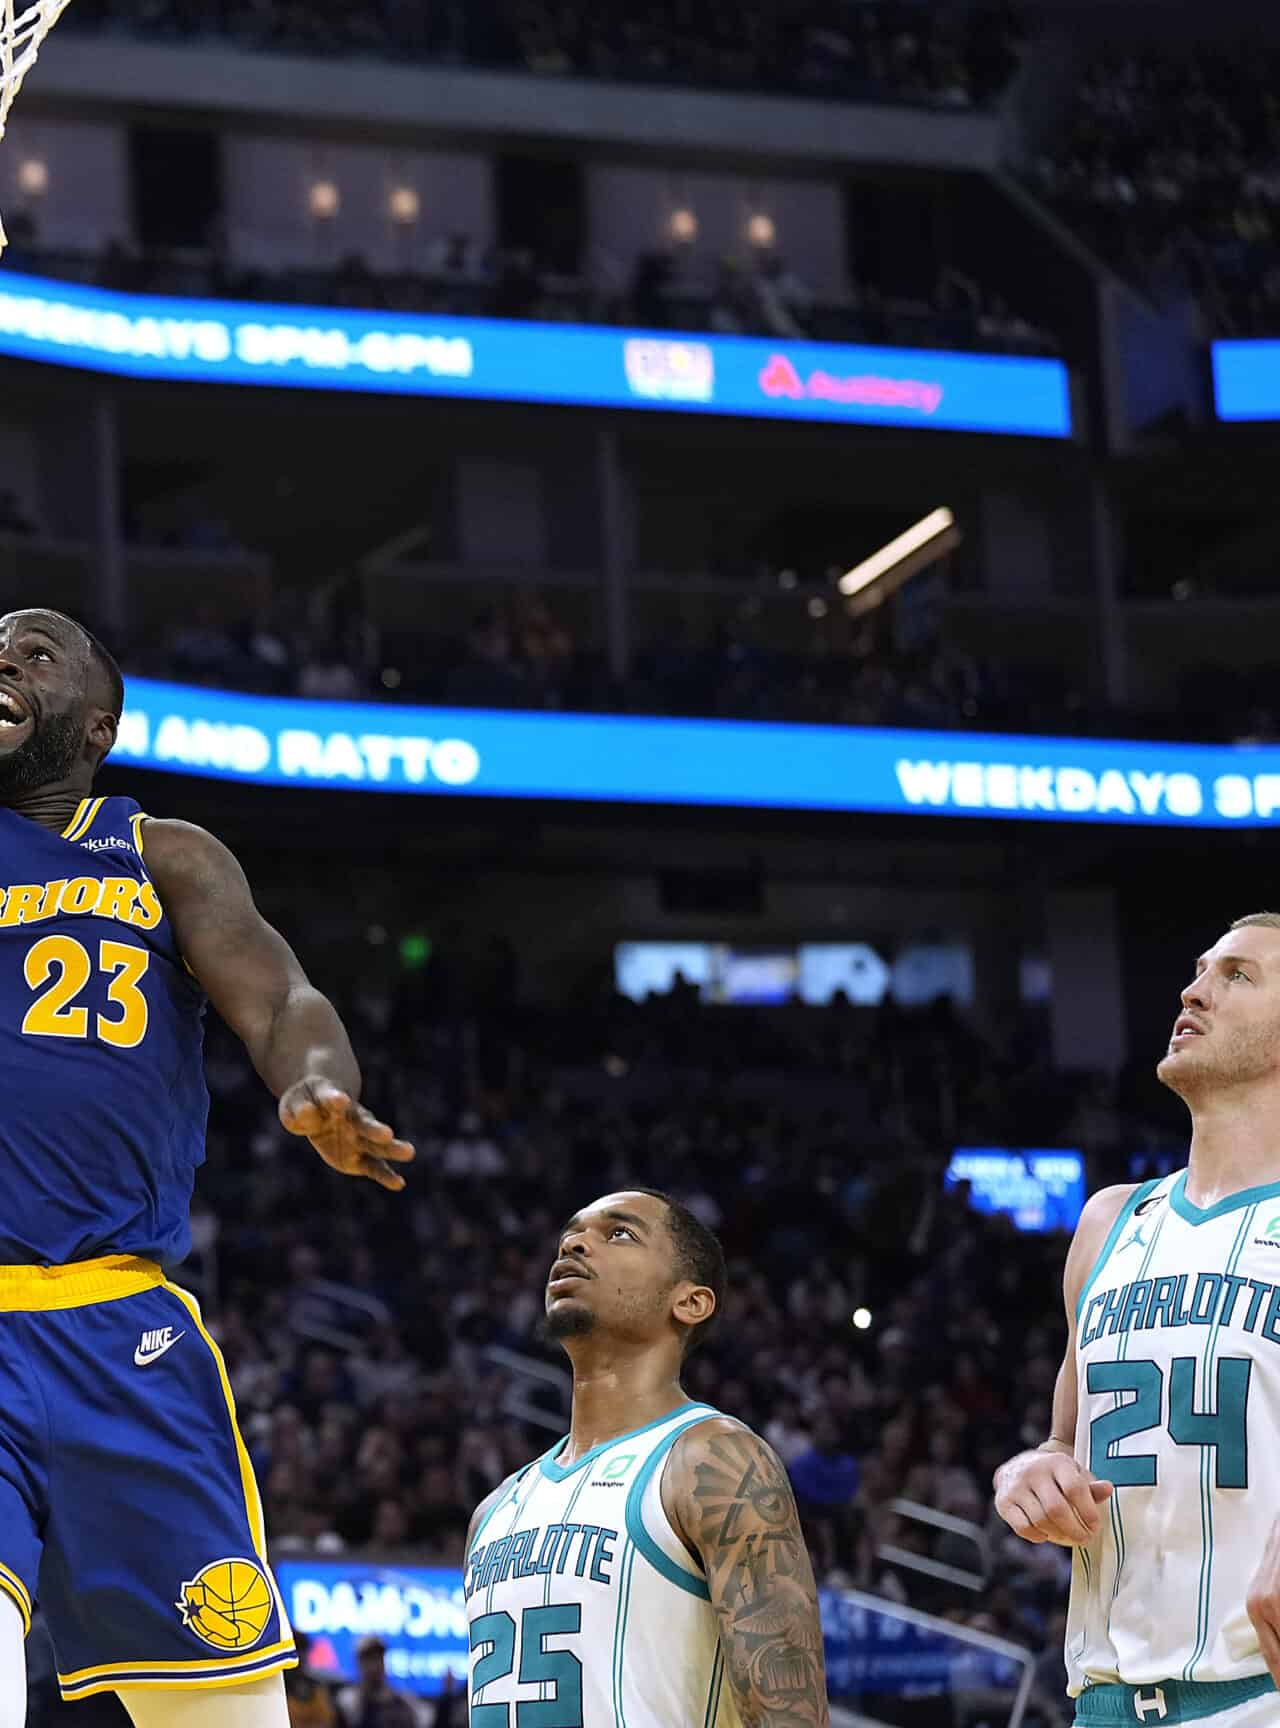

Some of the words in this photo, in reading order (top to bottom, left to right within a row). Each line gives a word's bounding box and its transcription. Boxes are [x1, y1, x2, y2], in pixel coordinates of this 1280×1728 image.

[154, 714, 270, 772] AND
[277, 729, 480, 785] RATTO
[895, 758, 1203, 817] WEEKDAYS
[21, 934, 150, 1048] 23
[140, 1326, 173, 1353] NIKE
[1086, 1356, 1254, 1489] 24
[469, 1602, 585, 1728] 25
